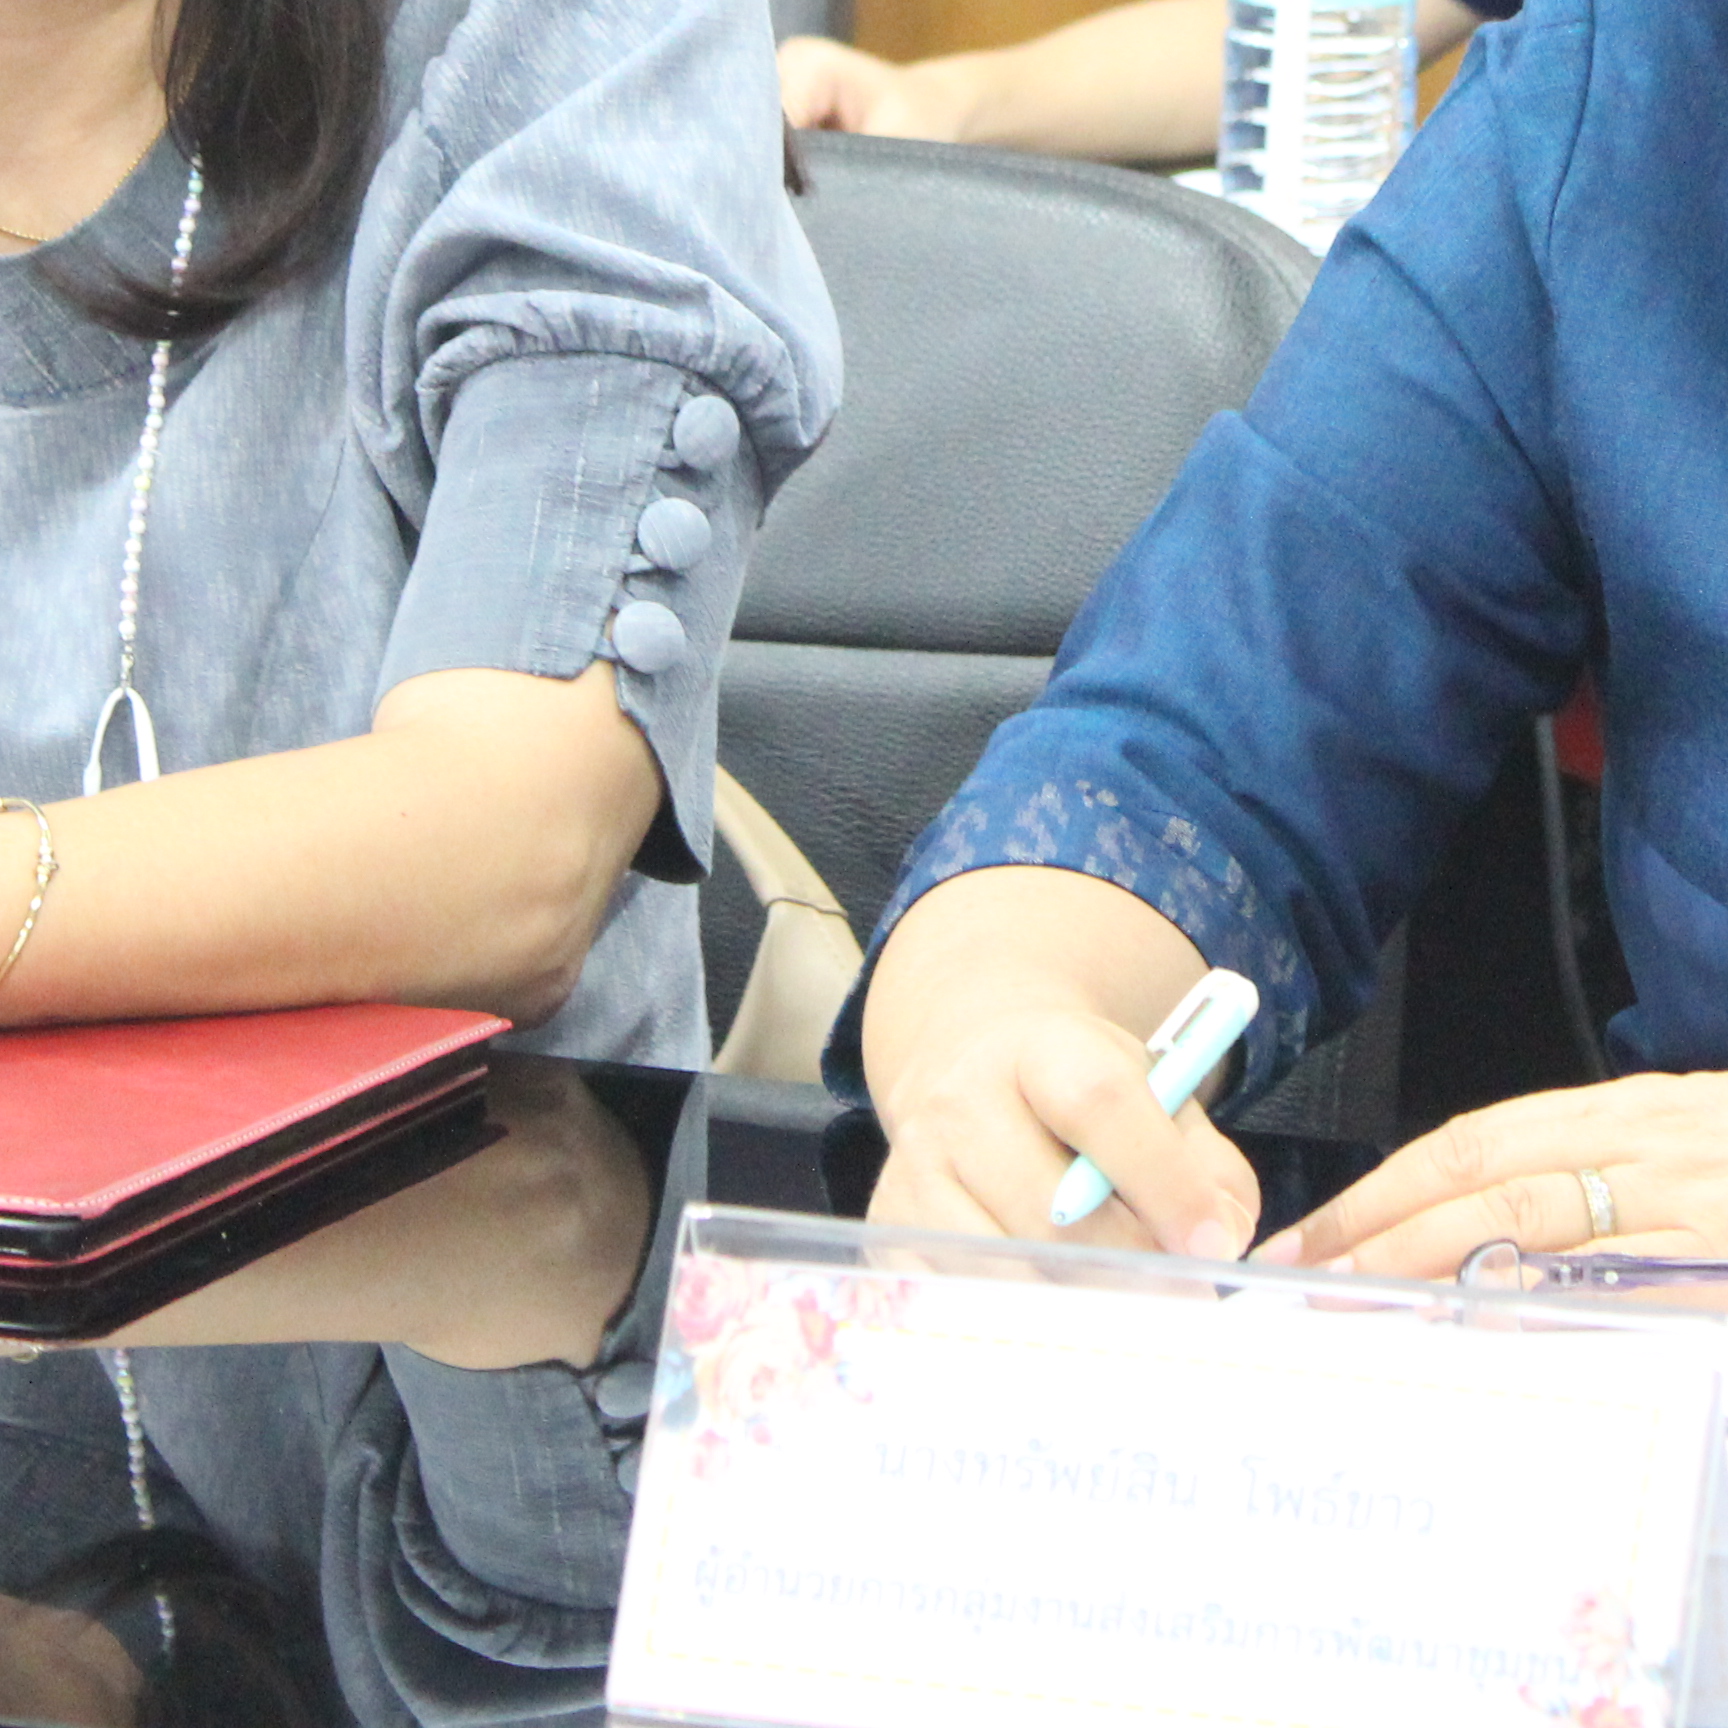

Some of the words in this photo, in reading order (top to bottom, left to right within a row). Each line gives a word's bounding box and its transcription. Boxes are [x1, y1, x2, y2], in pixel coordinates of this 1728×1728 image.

[875, 1435, 1199, 1511] นางทรัพย์สิน
[693, 1543, 1581, 1691] ผู้อำนวยการกลุ่มงานส่งเสริมการพัฒนาชุมชน
